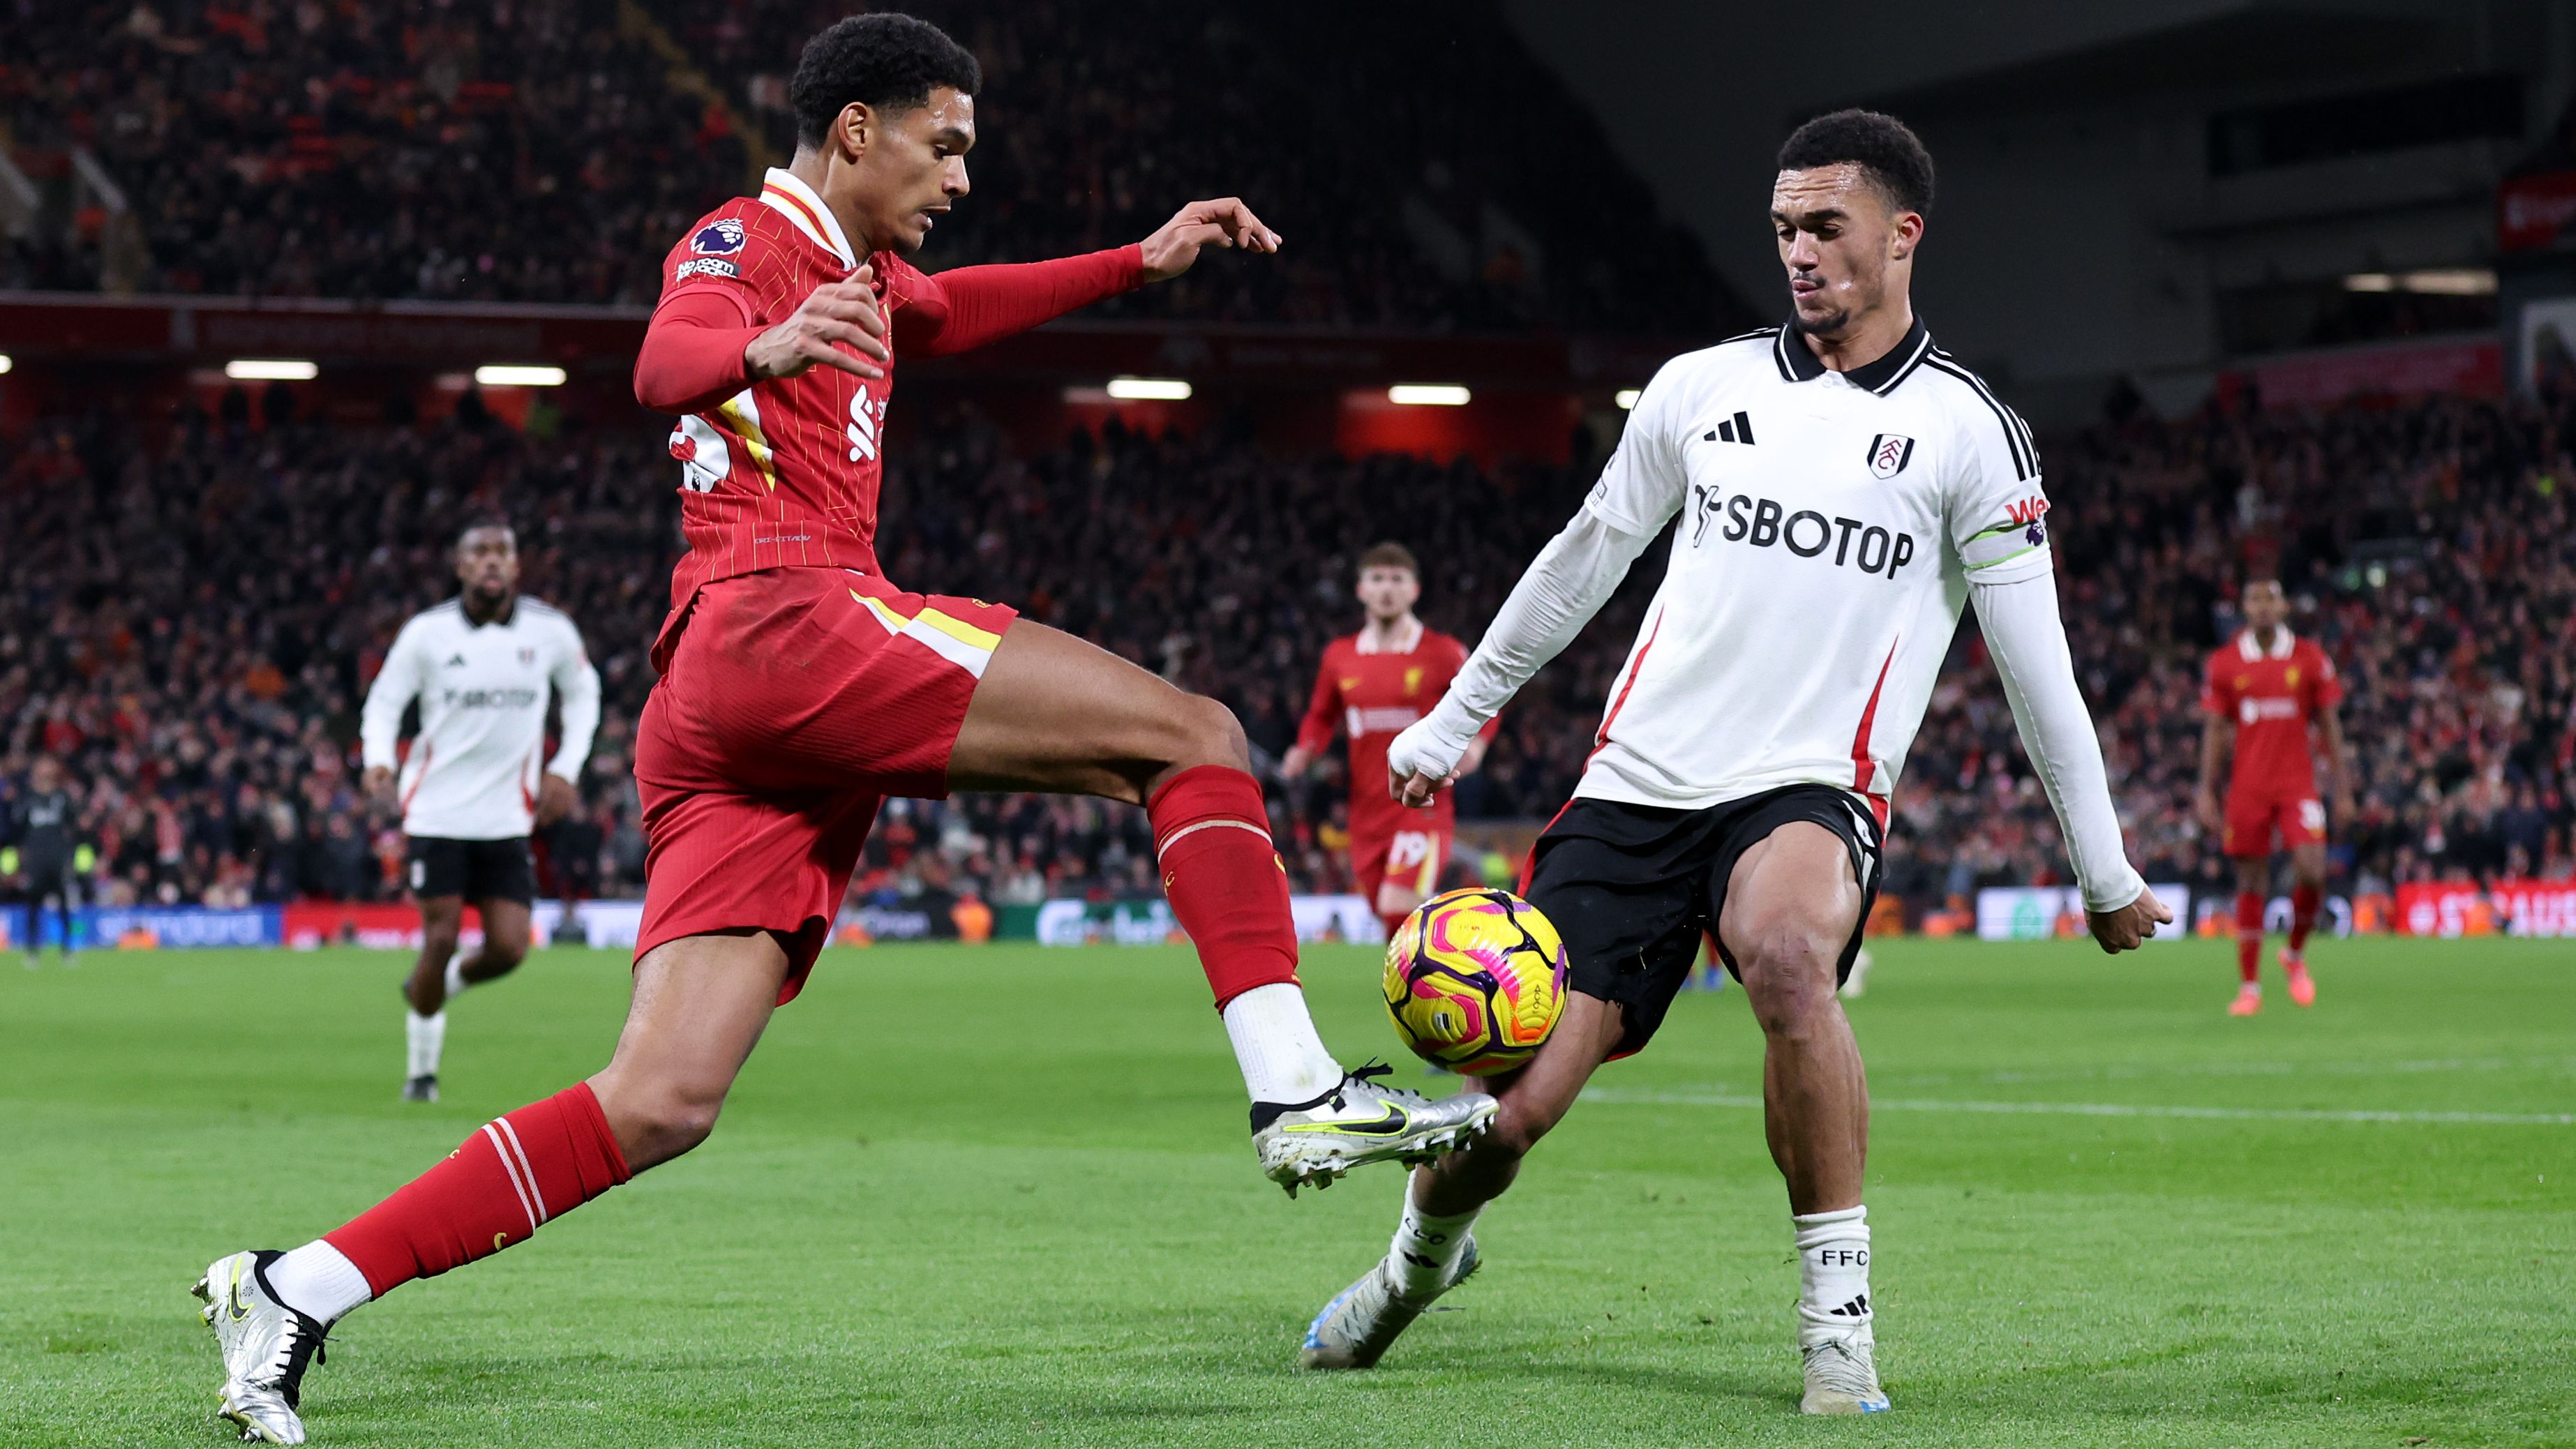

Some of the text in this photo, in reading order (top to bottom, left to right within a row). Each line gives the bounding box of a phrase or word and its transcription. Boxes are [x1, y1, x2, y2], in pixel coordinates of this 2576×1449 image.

[696, 257, 734, 274] room
[1723, 493, 1914, 580] SBOTOP
[1822, 1249, 1869, 1267] FFC
